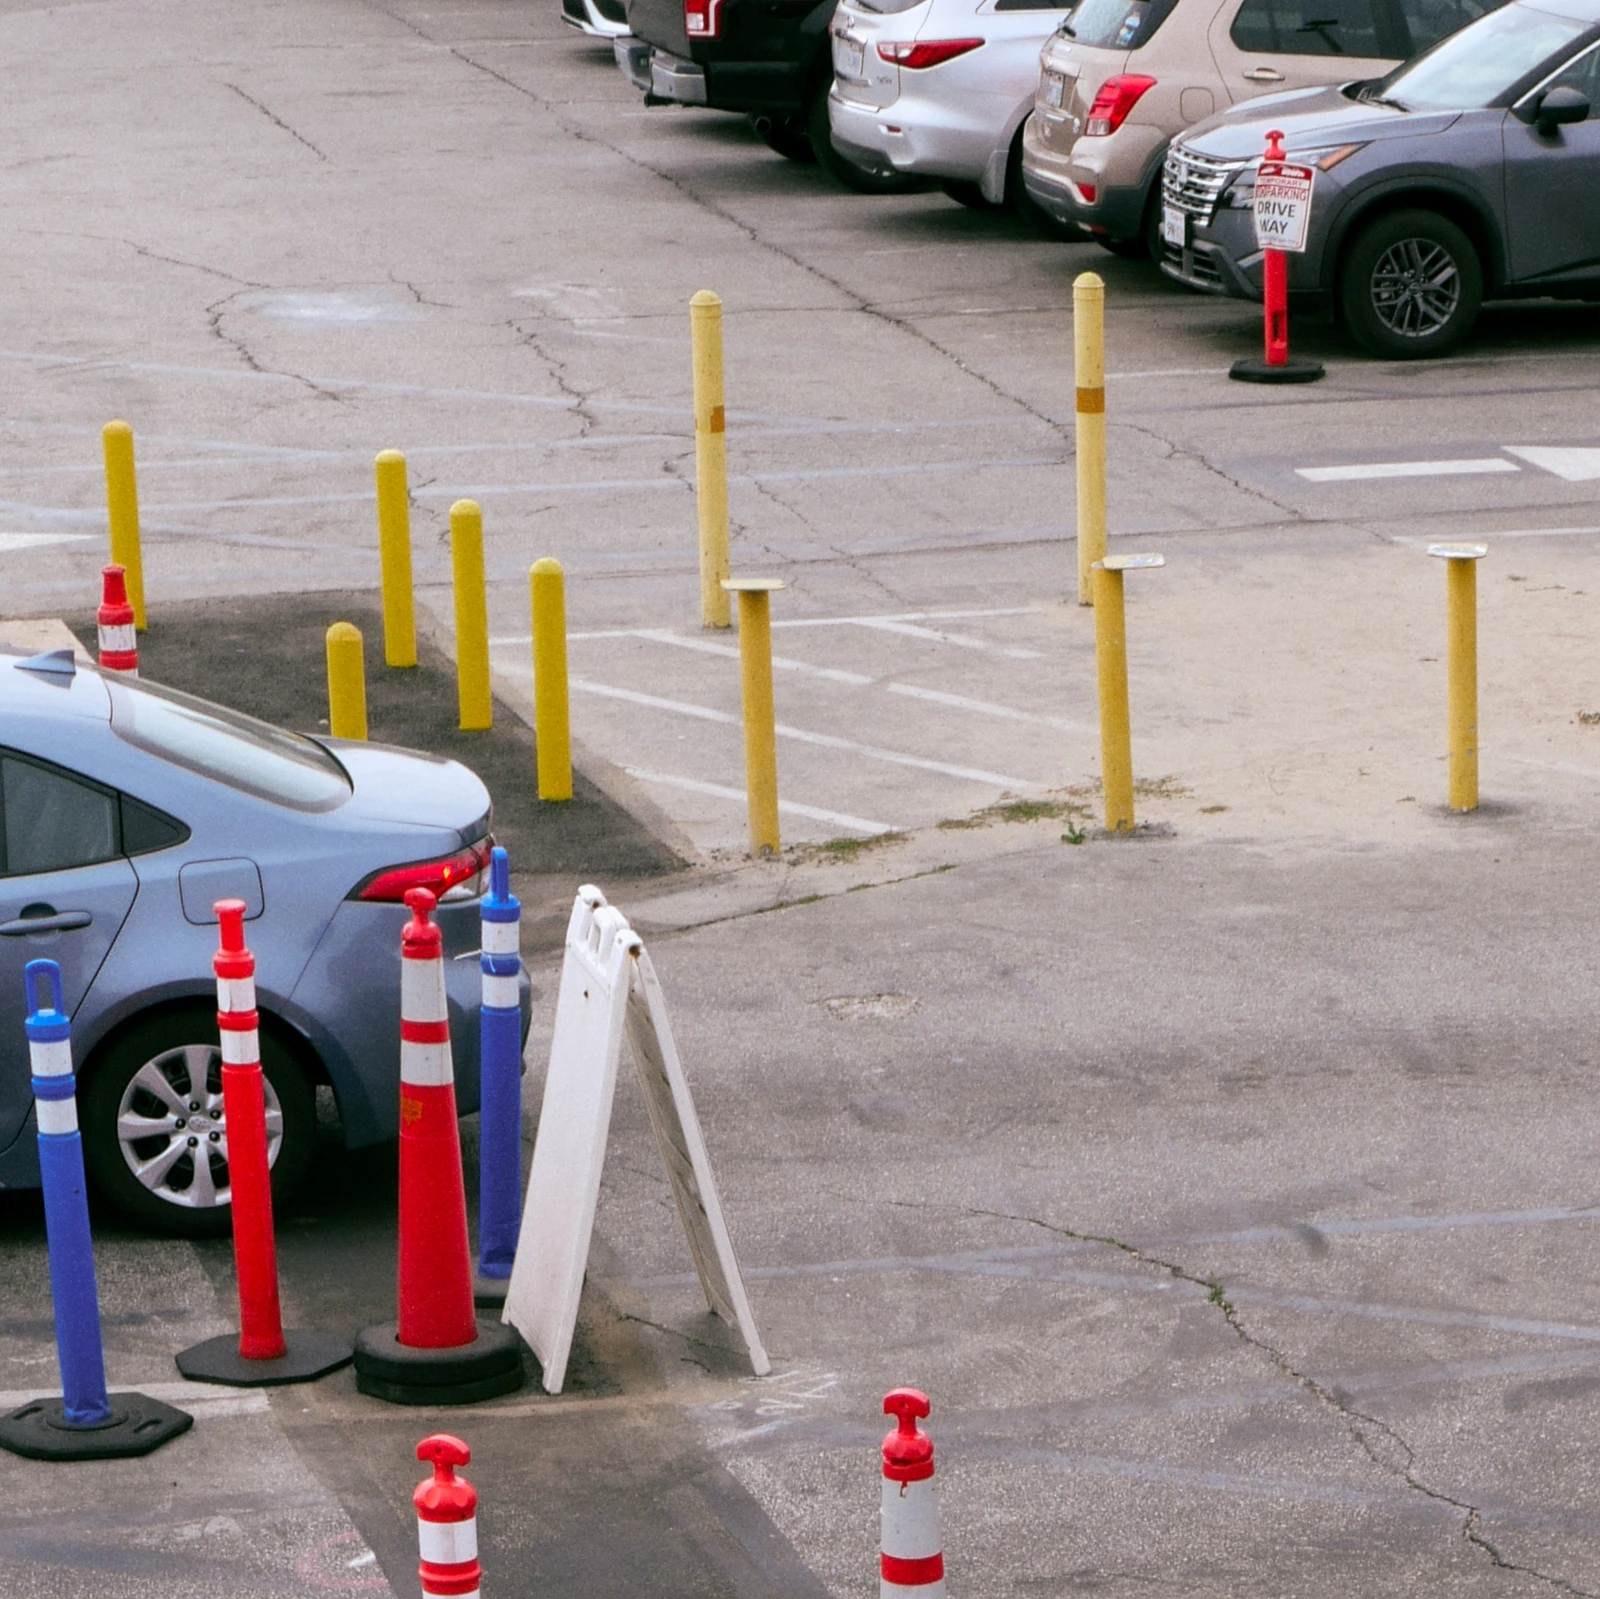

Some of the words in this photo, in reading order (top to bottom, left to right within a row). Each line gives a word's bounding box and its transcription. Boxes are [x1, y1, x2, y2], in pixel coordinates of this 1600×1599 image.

[1266, 186, 1307, 201] PARKING
[1257, 201, 1296, 218] DRIVE
[1259, 219, 1289, 235] WAY
